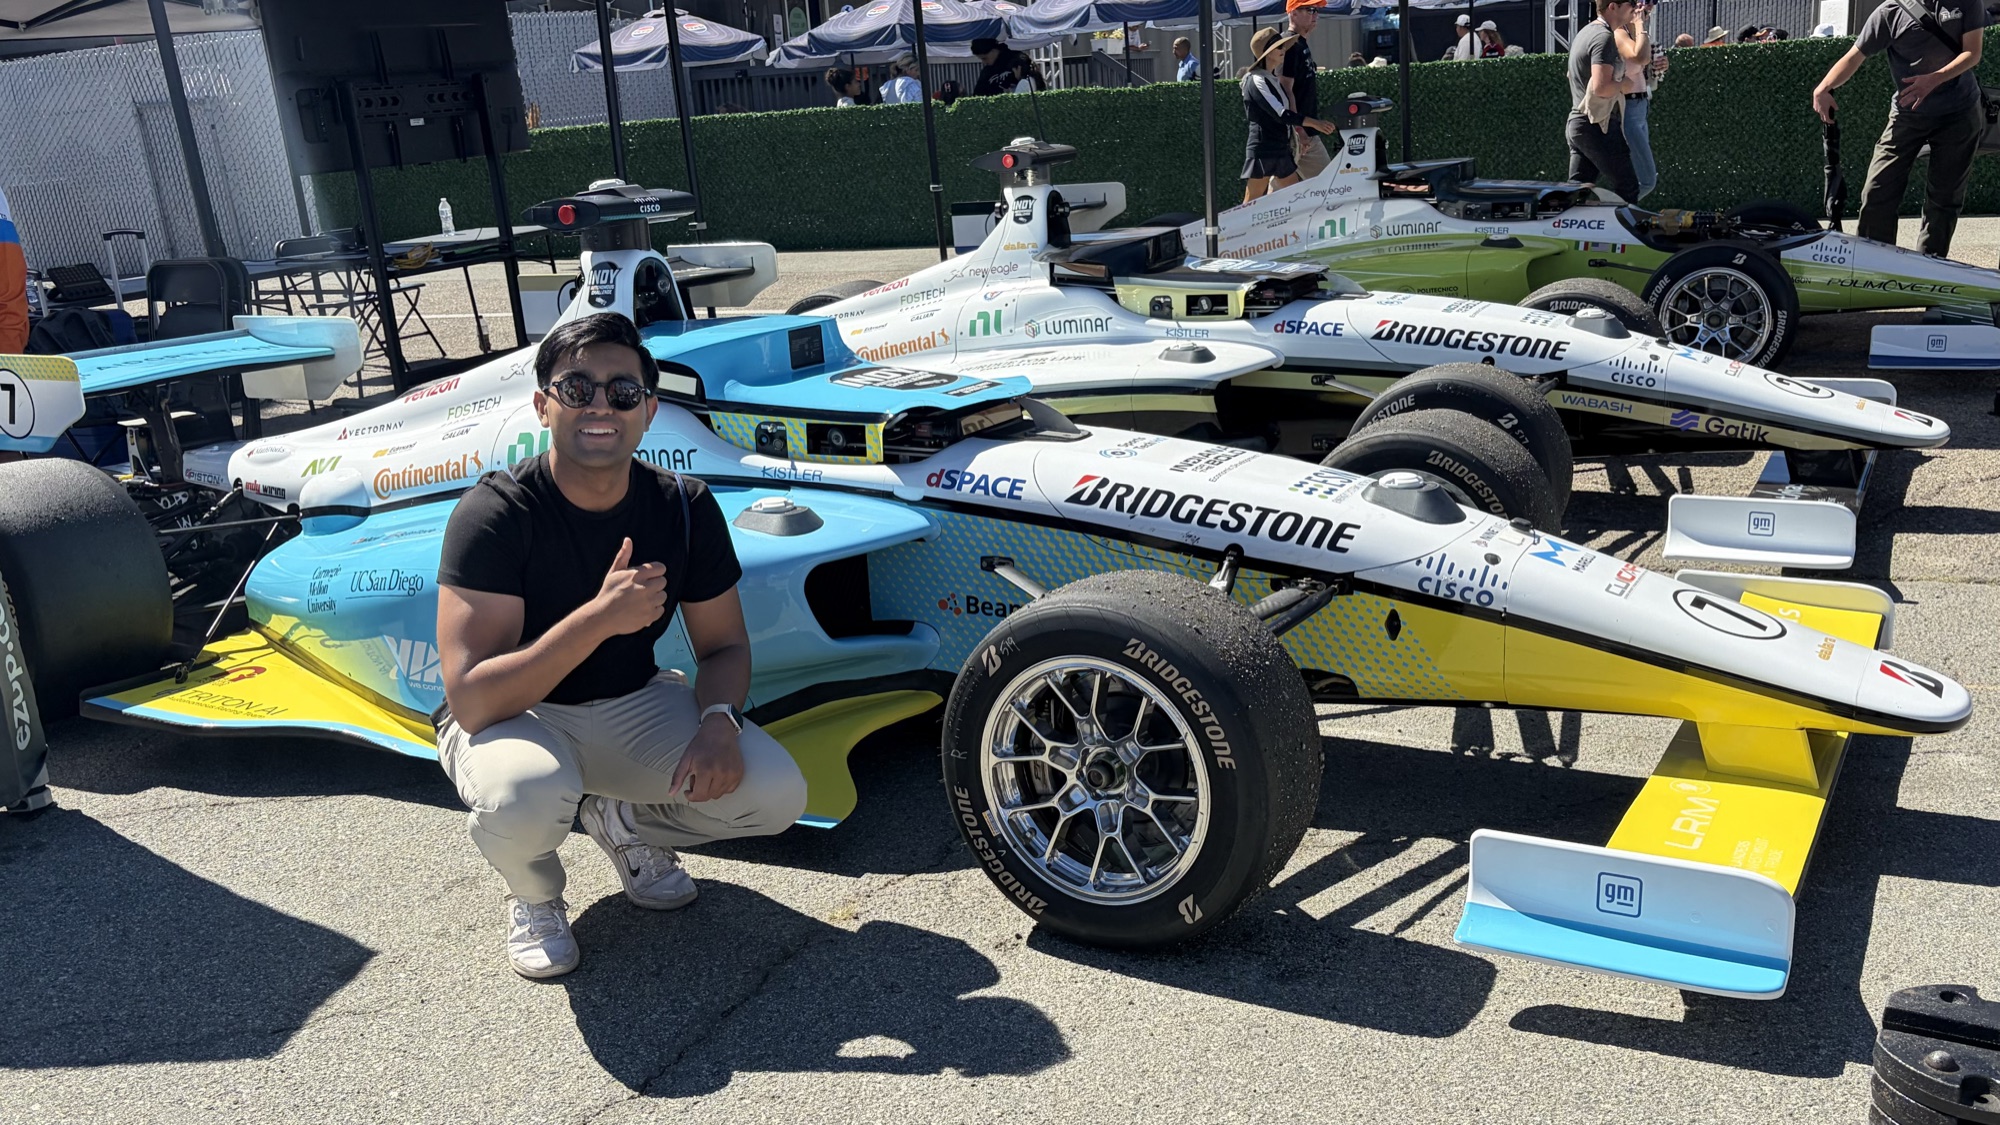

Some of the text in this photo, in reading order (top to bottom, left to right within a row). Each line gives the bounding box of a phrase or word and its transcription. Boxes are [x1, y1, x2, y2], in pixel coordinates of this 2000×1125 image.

[1347, 136, 1368, 146] INDY
[639, 203, 661, 213] CISCO
[1011, 199, 1035, 210] INDY
[1252, 206, 1291, 222] FOSTECH
[1386, 221, 1442, 236] LUMINAR
[1552, 219, 1605, 230] dSPACE
[1812, 253, 1846, 265] CISCO
[588, 269, 621, 285] INDY
[862, 278, 909, 298] verizon
[900, 287, 946, 306] FOSTECH
[1417, 286, 1459, 294] POLITECNICO
[1648, 274, 1671, 309] ESTONE
[1045, 317, 1113, 335] LUMINAR
[1166, 328, 1209, 338] KISTLER
[1274, 320, 1345, 337] dSPACE
[856, 331, 937, 362] Continental
[1370, 320, 1571, 361] BRIDGESTONE
[1757, 310, 1788, 369] BRIDGESTON
[1611, 373, 1656, 388] CISCO
[1776, 377, 1820, 394] 2
[404, 377, 460, 404] verizon
[447, 396, 502, 421] FOSTECH
[1561, 393, 1633, 414] WABASH
[349, 420, 404, 437] VECTORNAV
[442, 428, 471, 441] CALIAN
[1705, 417, 1769, 442] Gatik
[301, 456, 342, 478] AVI
[633, 448, 698, 471] MINAR
[373, 455, 468, 500] Continental
[762, 466, 823, 482] KISTLER
[926, 468, 1026, 499] dSPACE
[1427, 451, 1509, 520] BRIDGESTON
[1064, 475, 1361, 554] BRIDGESTONE
[1752, 517, 1771, 531] gm
[312, 564, 342, 581] Carnegie
[308, 582, 329, 596] Mellon
[350, 569, 424, 596] UC San Diego
[1417, 576, 1494, 607] CISCO
[307, 598, 337, 615] University
[181, 689, 263, 711] TRITON
[1122, 638, 1237, 770] BRIDGESTONE
[1664, 796, 1721, 850] LRM
[954, 785, 1048, 915] BRIDGESTONE
[1605, 882, 1634, 907] gm
